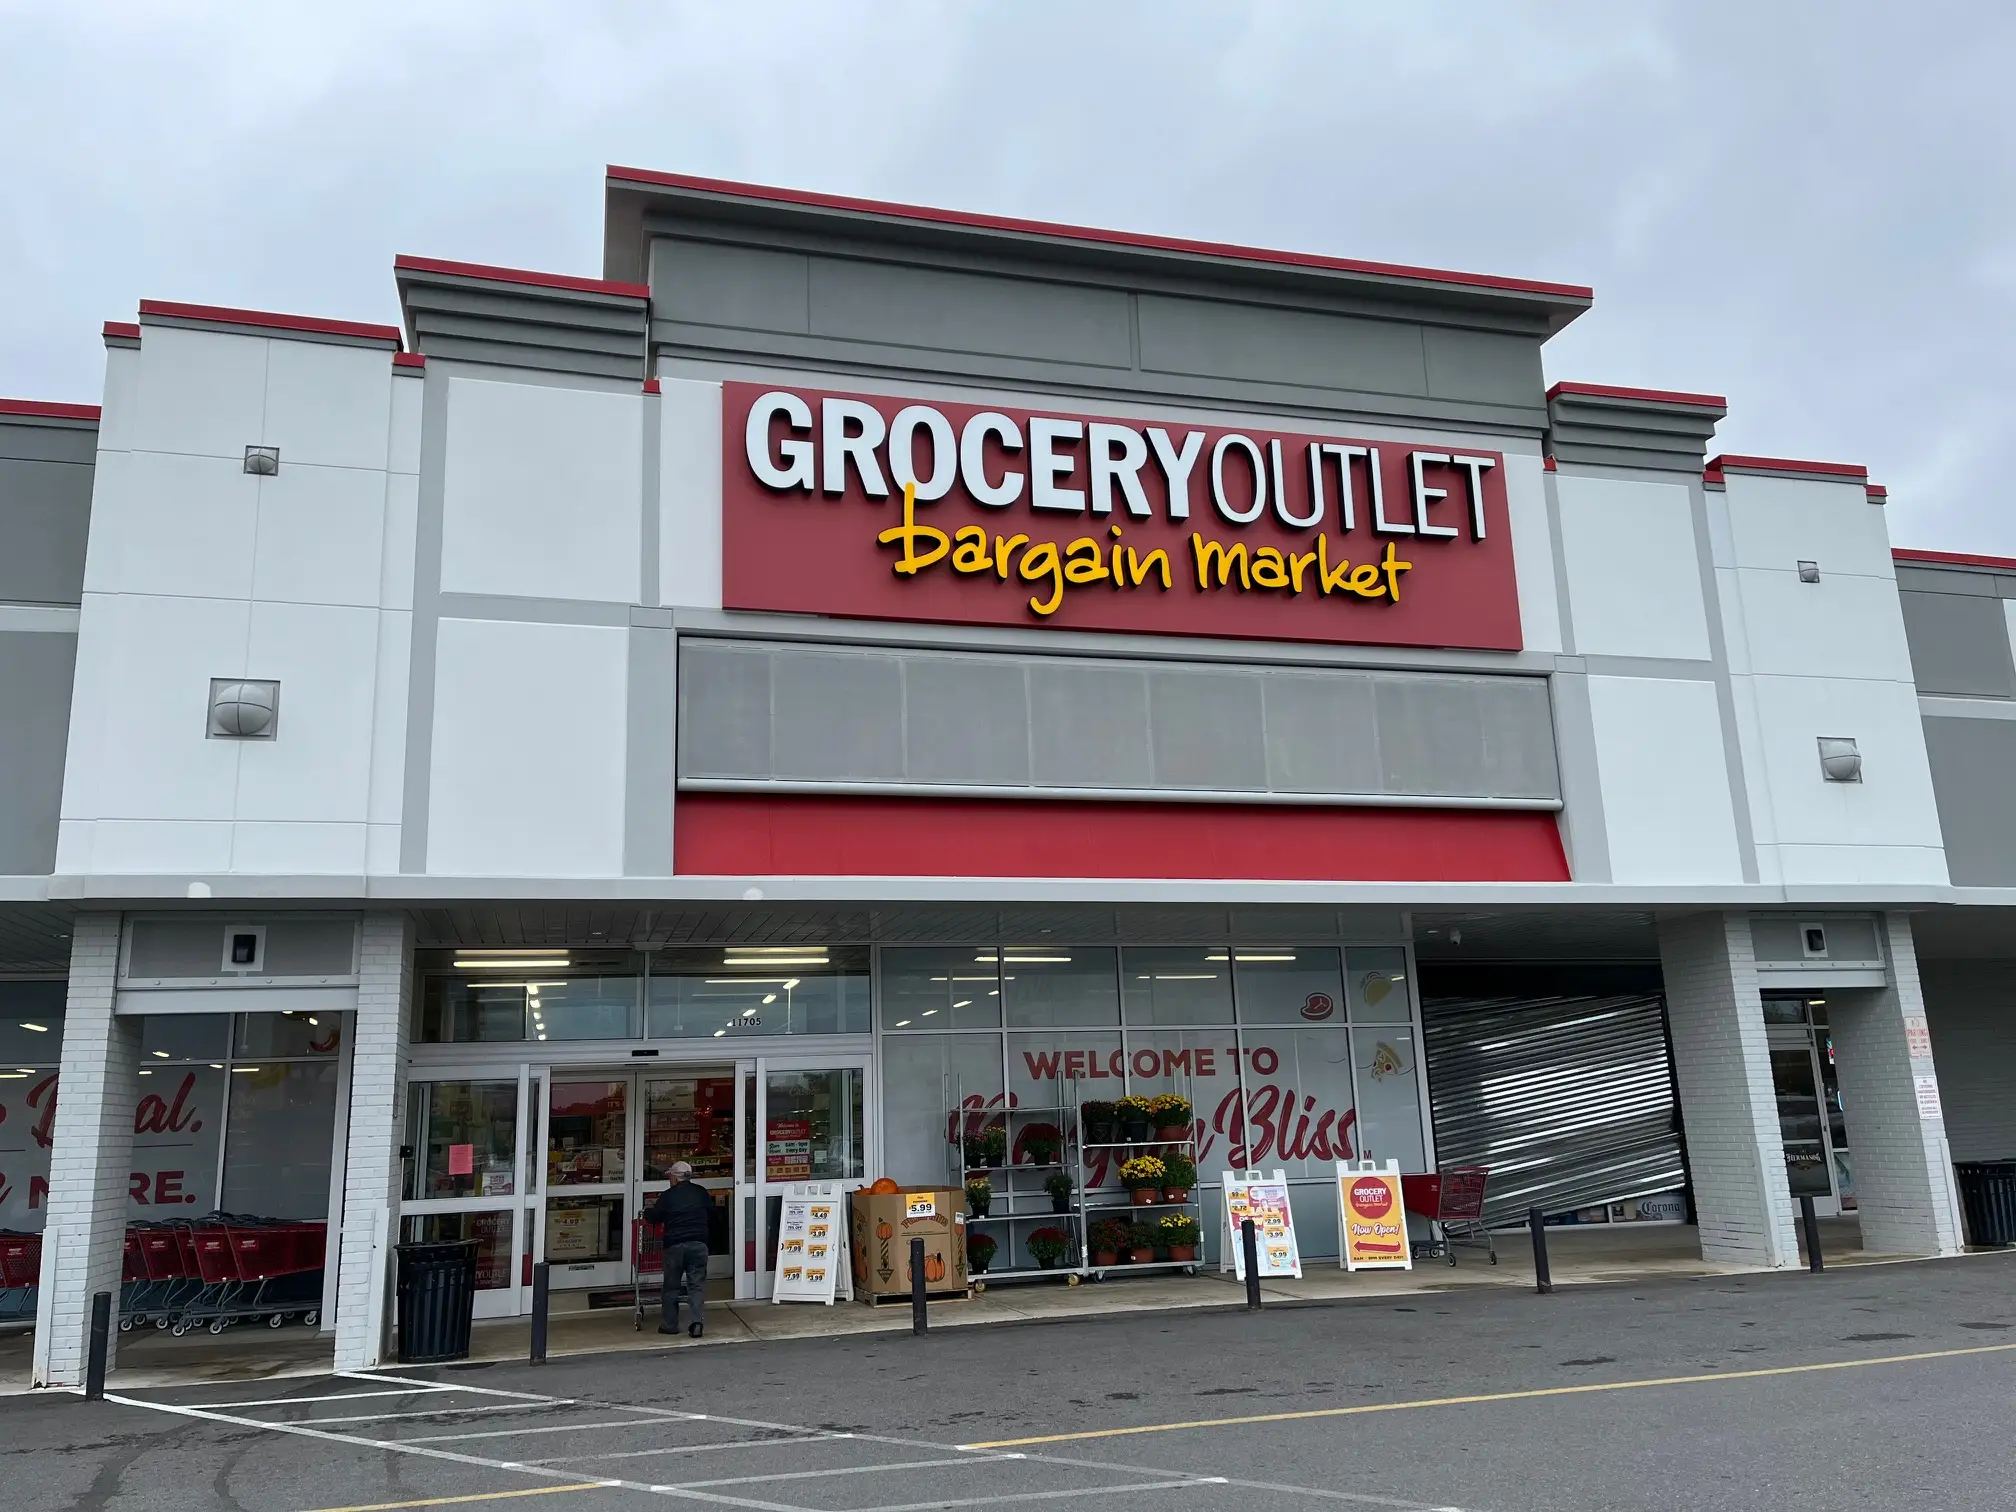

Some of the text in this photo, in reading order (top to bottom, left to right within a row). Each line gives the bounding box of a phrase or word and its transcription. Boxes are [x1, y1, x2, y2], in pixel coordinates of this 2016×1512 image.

[876, 481, 1413, 617] bargain market
[731, 1017, 762, 1027] 11705
[1023, 1046, 1279, 1080] WELCOME TO
[1212, 1083, 1357, 1170] Bliss
[1353, 1188, 1387, 1196] GROCERY
[1359, 1194, 1383, 1202] OUTLET
[1642, 1201, 1680, 1216] Corona
[1351, 1222, 1400, 1237] Now Open!
